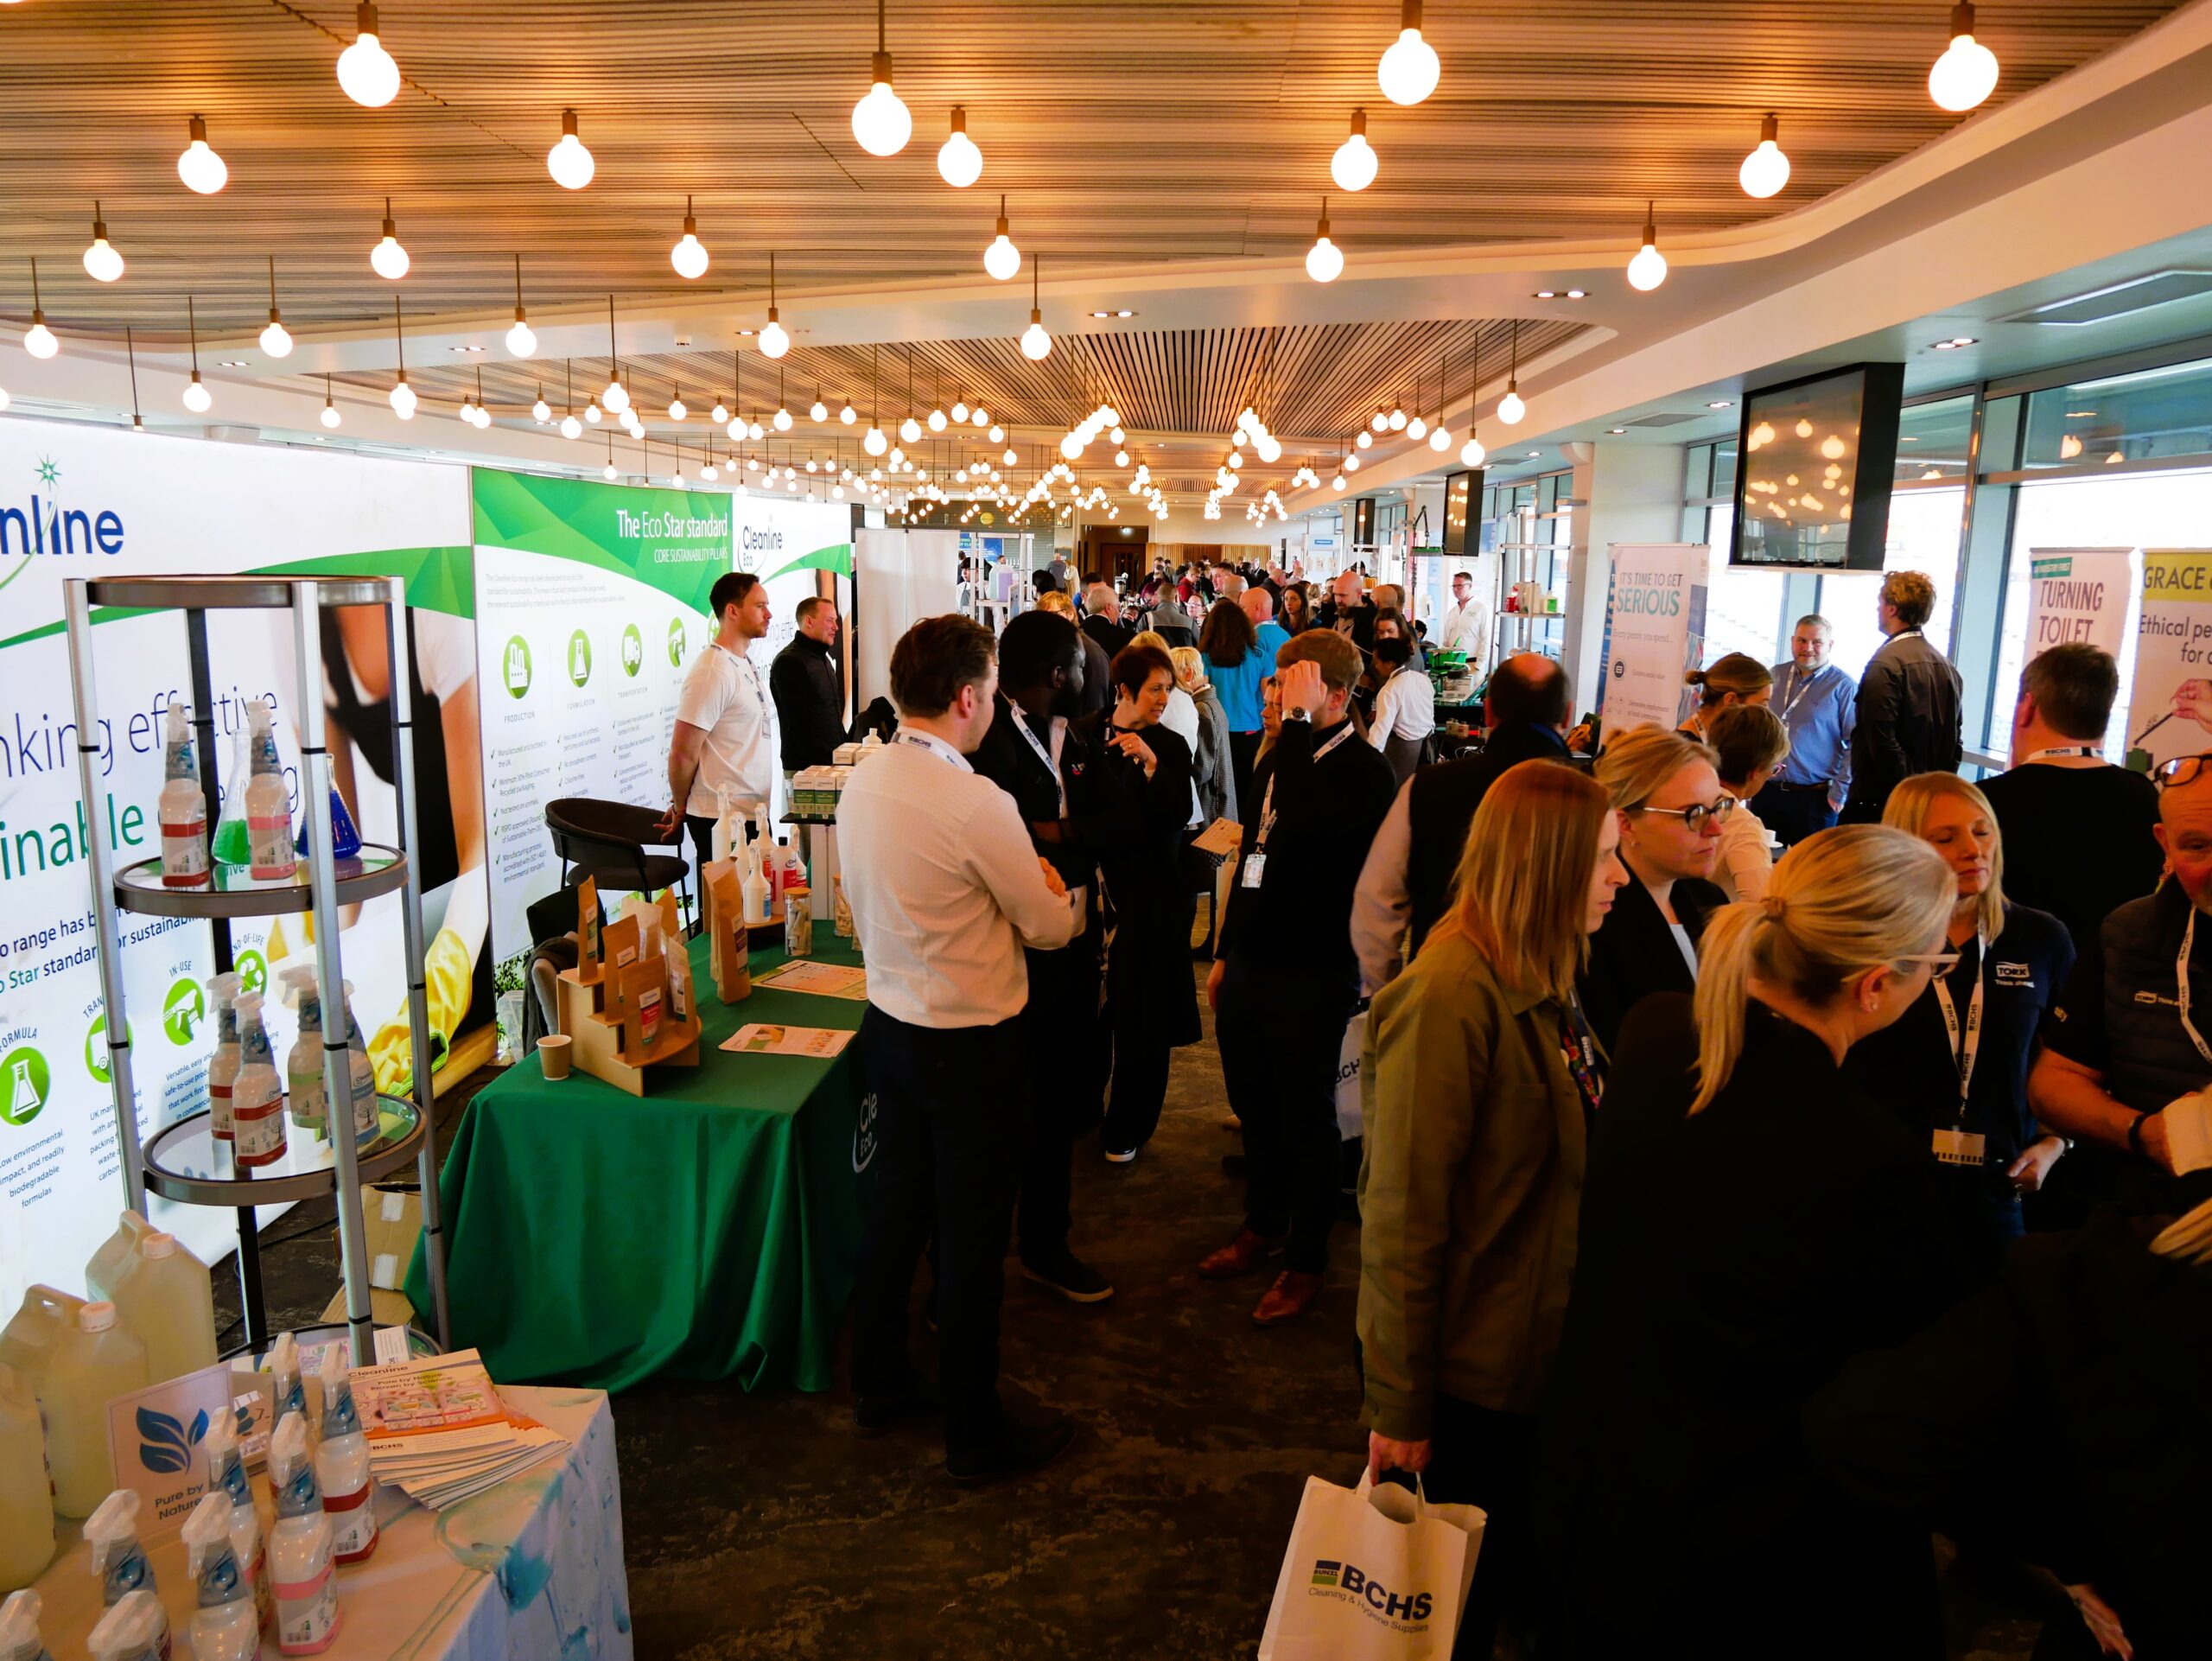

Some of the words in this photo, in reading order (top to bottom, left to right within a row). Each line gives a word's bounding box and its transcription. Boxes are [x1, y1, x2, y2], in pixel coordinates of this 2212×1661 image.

[616, 509, 639, 538] The
[642, 511, 662, 538] Eco
[664, 512, 685, 538] Star
[687, 512, 728, 538] standard
[742, 525, 783, 550] Cleanline
[654, 549, 671, 563] CORE
[671, 547, 709, 563] SUSTAINABILITY
[709, 546, 728, 562] PILLARS
[742, 552, 753, 567] Eco
[1620, 572, 1632, 585] IT'S
[1635, 573, 1651, 586] TIME
[1654, 573, 1665, 586] TO
[1667, 574, 1683, 587] GET
[2143, 566, 2206, 589] GRACE
[1616, 588, 1681, 617] SERIOUS
[2039, 581, 2104, 612] TURNING
[2038, 615, 2094, 646] TOILET
[2139, 614, 2190, 637] Ethical
[2192, 624, 2212, 644] pe
[2180, 641, 2204, 664] for
[504, 711, 536, 723] PRODUCTION
[13, 924, 57, 954] range
[60, 909, 85, 938] has
[232, 932, 265, 956] ND-OF-LIFE
[10, 965, 40, 990] Star
[43, 945, 97, 977] standar
[169, 960, 192, 978] IN-USE
[1997, 967, 2027, 977] TORK
[1969, 1003, 1978, 1026] BCHS
[166, 1062, 190, 1081] Versatile,
[190, 1058, 203, 1072] easy
[203, 1051, 213, 1063] and
[164, 1078, 194, 1098] safe-to-use
[168, 1099, 180, 1111] that
[180, 1092, 193, 1106] work
[193, 1085, 206, 1099] first
[90, 1109, 100, 1121] UK
[175, 1112, 182, 1122] in
[182, 1097, 210, 1117] commercia
[861, 1091, 878, 1133] Cle
[92, 1124, 105, 1136] with
[13, 1129, 64, 1161] environmental
[90, 1136, 115, 1155] packing
[27, 1155, 41, 1171] and
[41, 1146, 66, 1163] readily
[98, 1150, 117, 1166] waste
[9, 1165, 60, 1199] biodegradable
[99, 1165, 120, 1182] carbon
[22, 1186, 53, 1208] formulas
[348, 1365, 409, 1378] Cleanline
[413, 1371, 443, 1380] Nature
[155, 1491, 183, 1508] Pure
[187, 1483, 204, 1497] by
[158, 1498, 201, 1520] Nature
[1340, 1564, 1433, 1621] BCHS
[1308, 1587, 1347, 1601] Cleaning
[1348, 1595, 1355, 1604] &
[1357, 1600, 1389, 1626] Hygiene
[1389, 1620, 1430, 1634] Supplies
